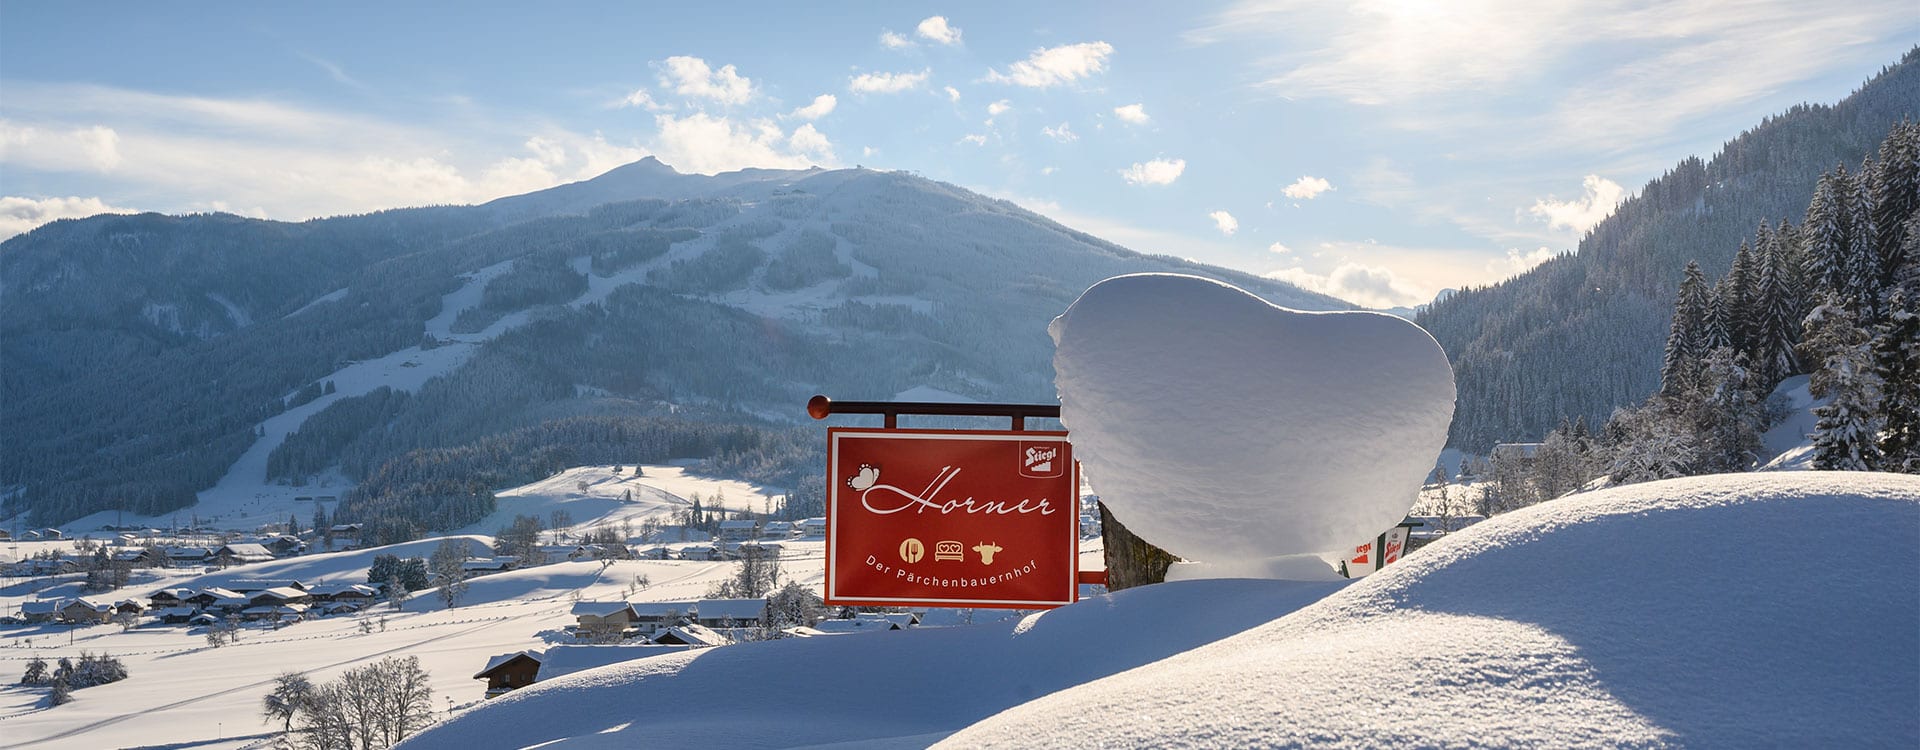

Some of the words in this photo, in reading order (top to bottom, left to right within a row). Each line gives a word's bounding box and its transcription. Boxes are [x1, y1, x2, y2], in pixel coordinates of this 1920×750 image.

[1025, 447, 1056, 467] Stiegl
[861, 465, 1056, 515] Horner
[866, 555, 890, 574] Der
[897, 560, 1037, 588] Pärchenbauernhof
